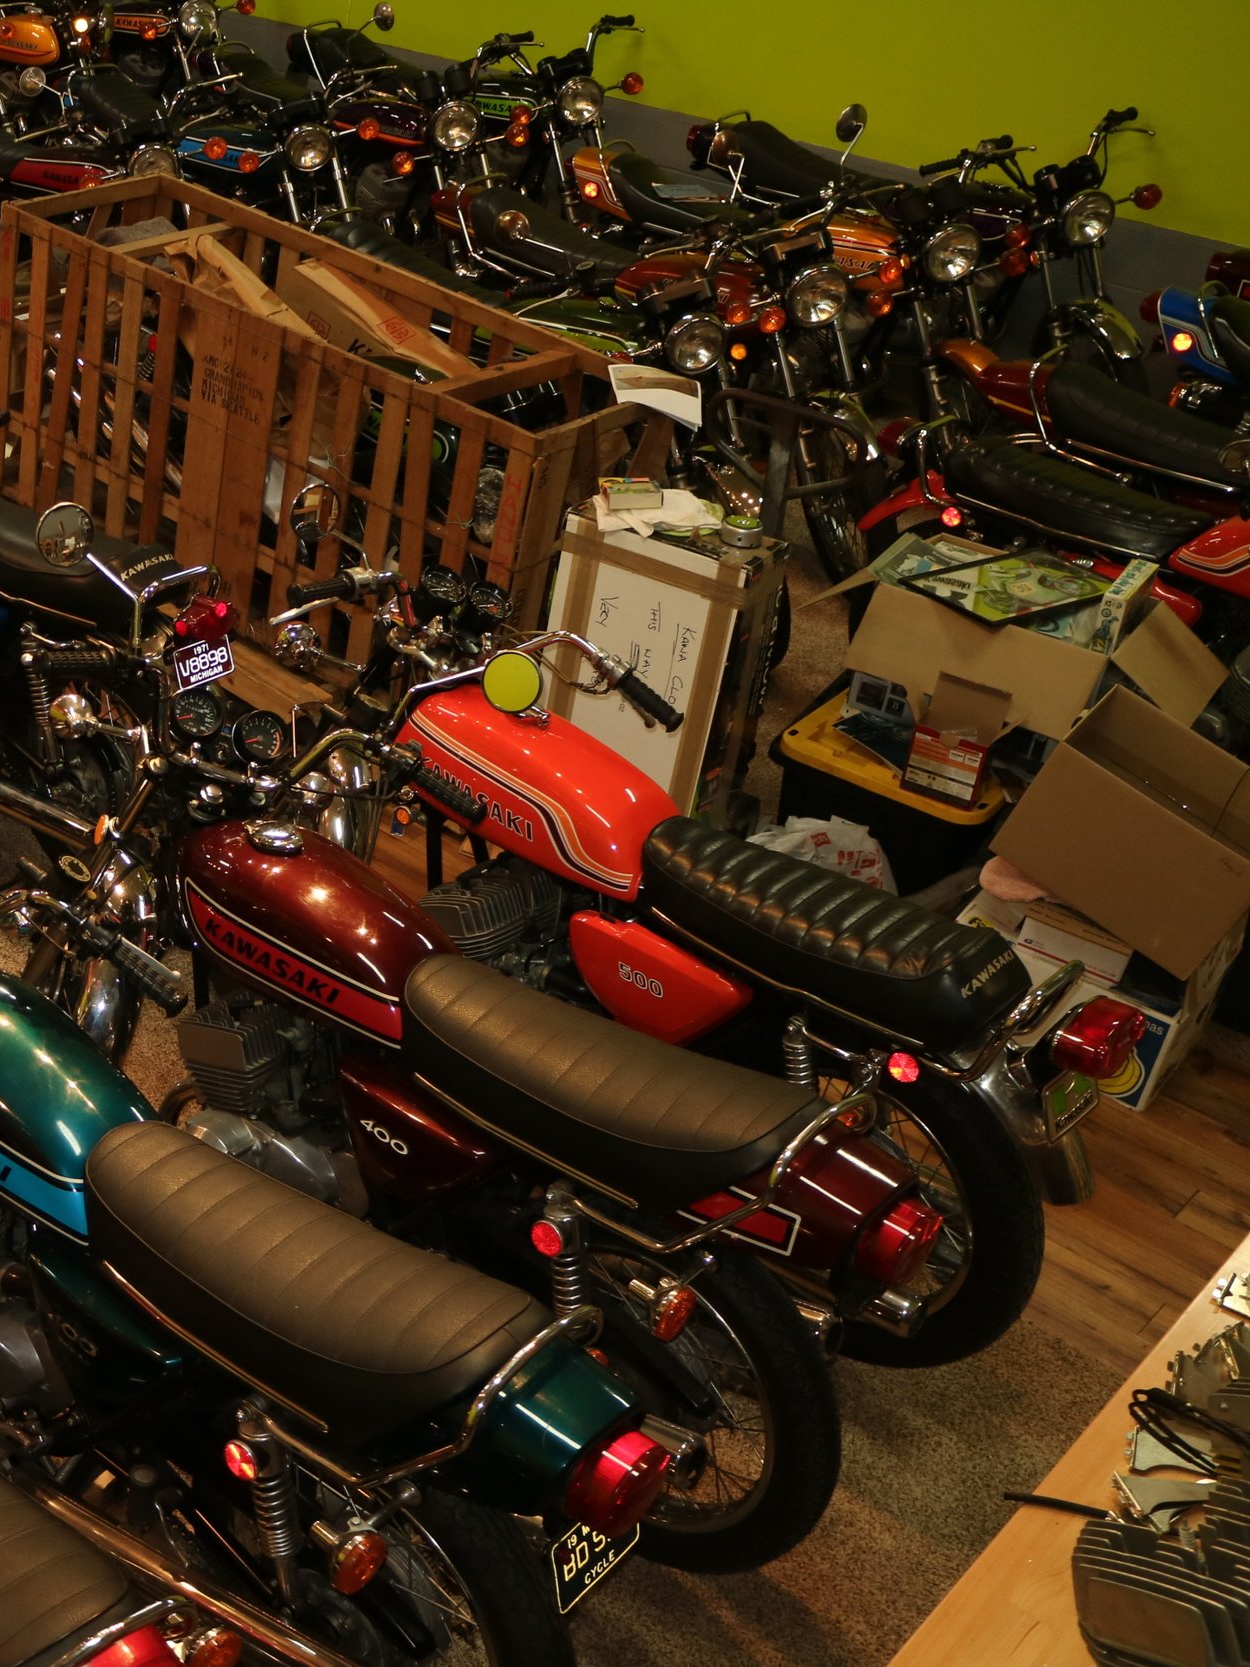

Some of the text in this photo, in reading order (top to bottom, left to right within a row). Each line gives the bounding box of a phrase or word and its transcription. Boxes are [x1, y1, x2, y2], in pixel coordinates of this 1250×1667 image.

[221, 398, 260, 425] SEATTLE
[120, 553, 175, 582] KAWASAKI
[179, 646, 229, 678] V8898
[193, 643, 209, 655] 1971
[190, 665, 224, 684] MICHIGAN
[206, 918, 341, 1005] KAWASAKI
[618, 961, 664, 998] 500
[960, 949, 1015, 999] KAWASAKI
[1054, 1088, 1096, 1133] Kawasaki
[360, 1118, 409, 1156] 400
[584, 1549, 616, 1585] CYCLE
